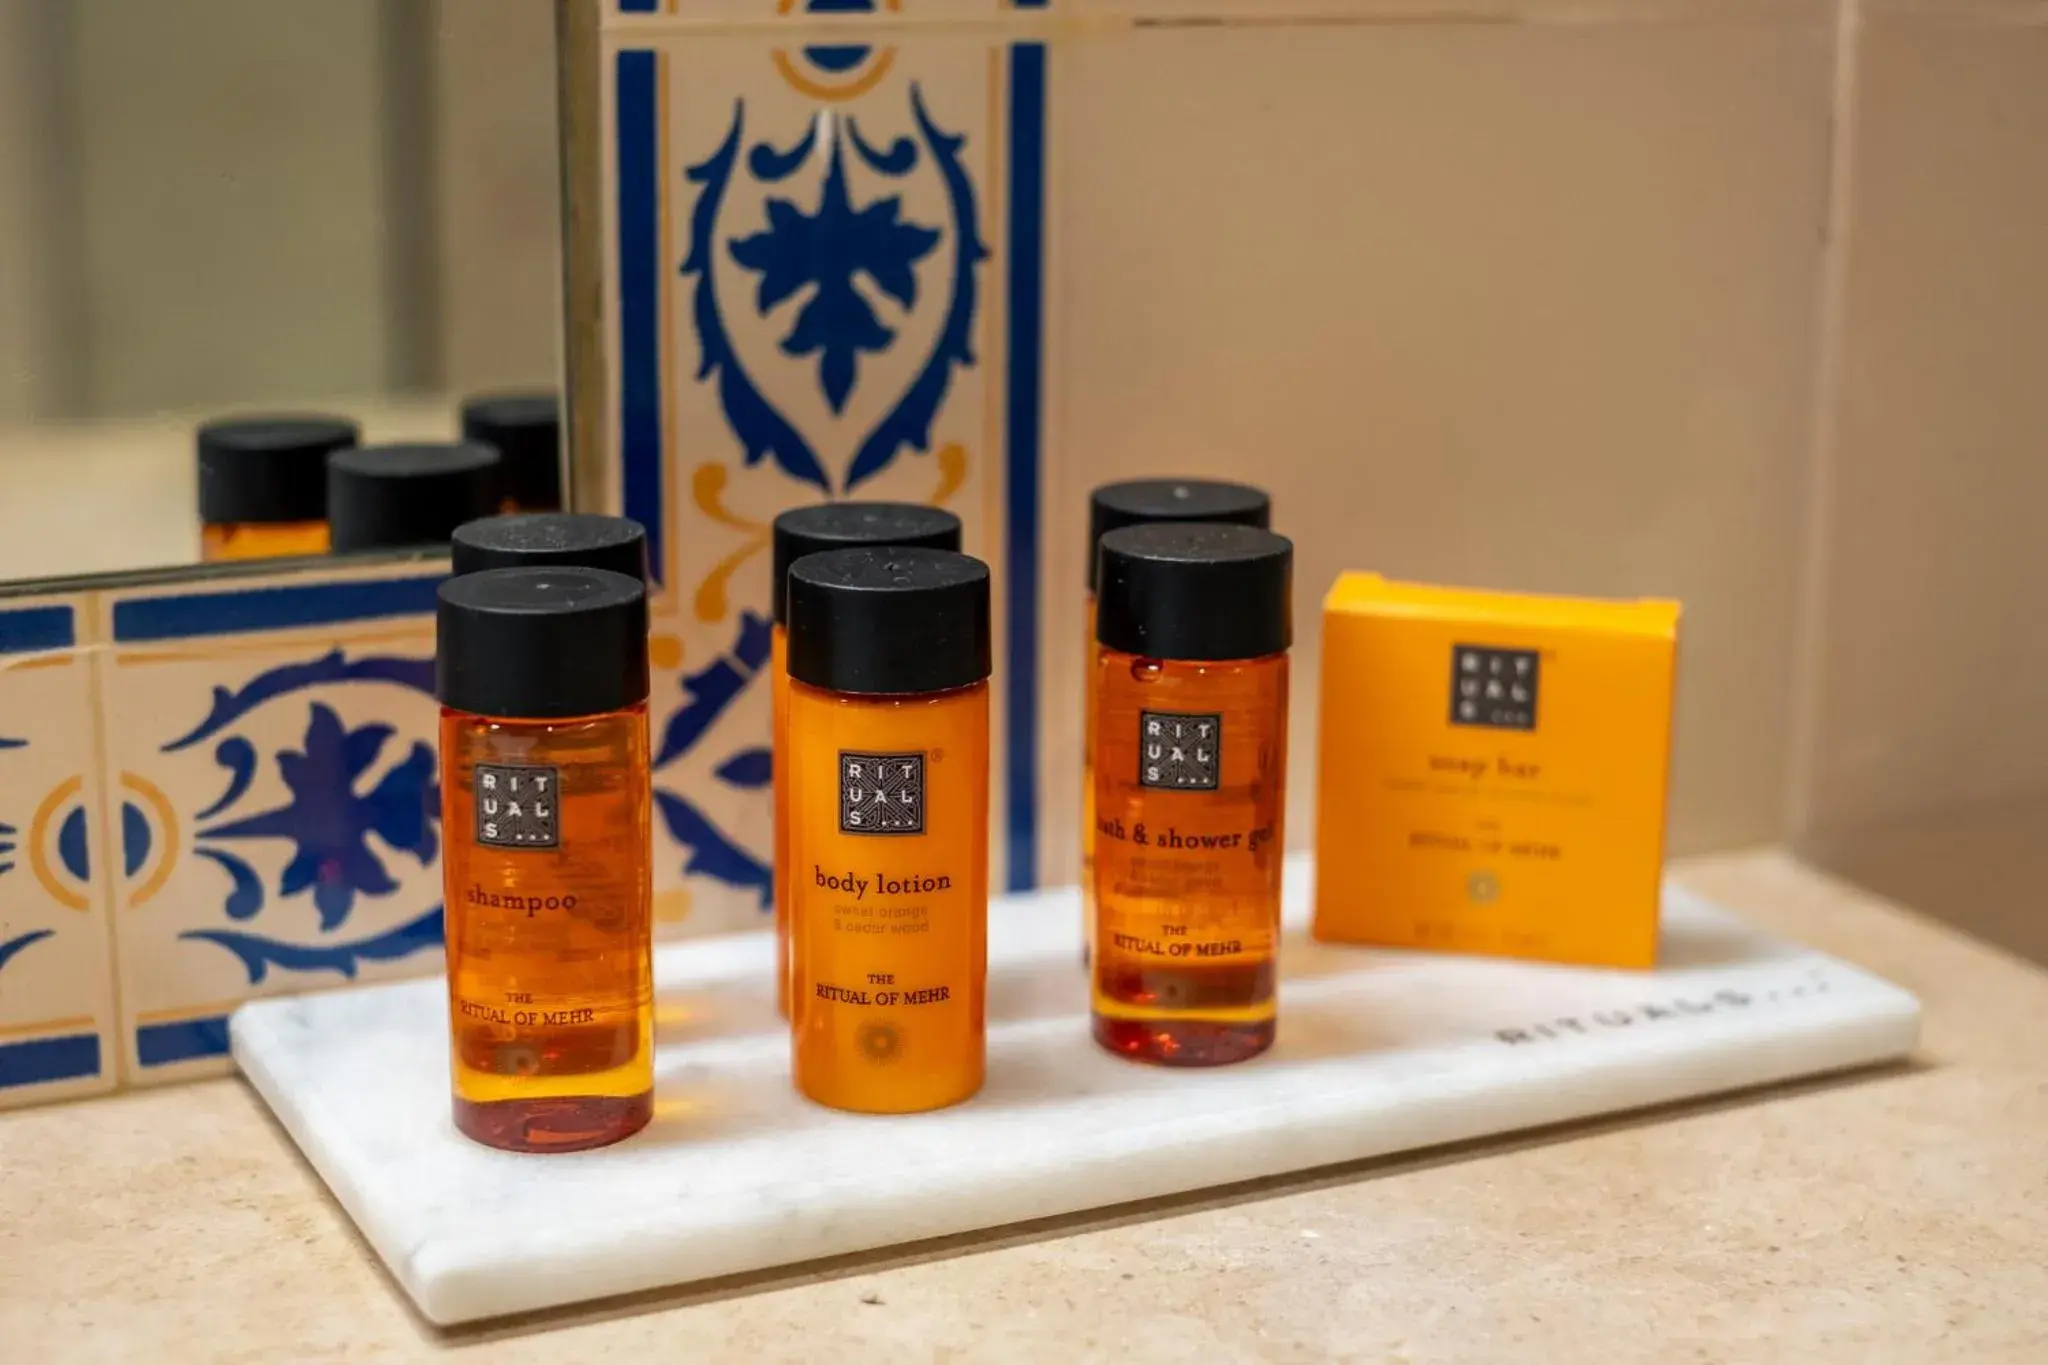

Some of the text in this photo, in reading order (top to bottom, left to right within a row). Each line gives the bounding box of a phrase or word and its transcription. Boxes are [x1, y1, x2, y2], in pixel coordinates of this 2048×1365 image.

[1132, 823, 1150, 846] &
[1157, 827, 1242, 849] shower
[814, 865, 952, 900] body lotion
[467, 884, 577, 916] shampoo
[1162, 924, 1187, 937] THE
[1113, 933, 1242, 957] RITUAL OF MEHR
[866, 973, 895, 985] THE
[504, 991, 534, 1005] THE
[816, 982, 951, 1006] RITUAL OF MEHR
[460, 999, 595, 1026] RITUAL OF MEHR
